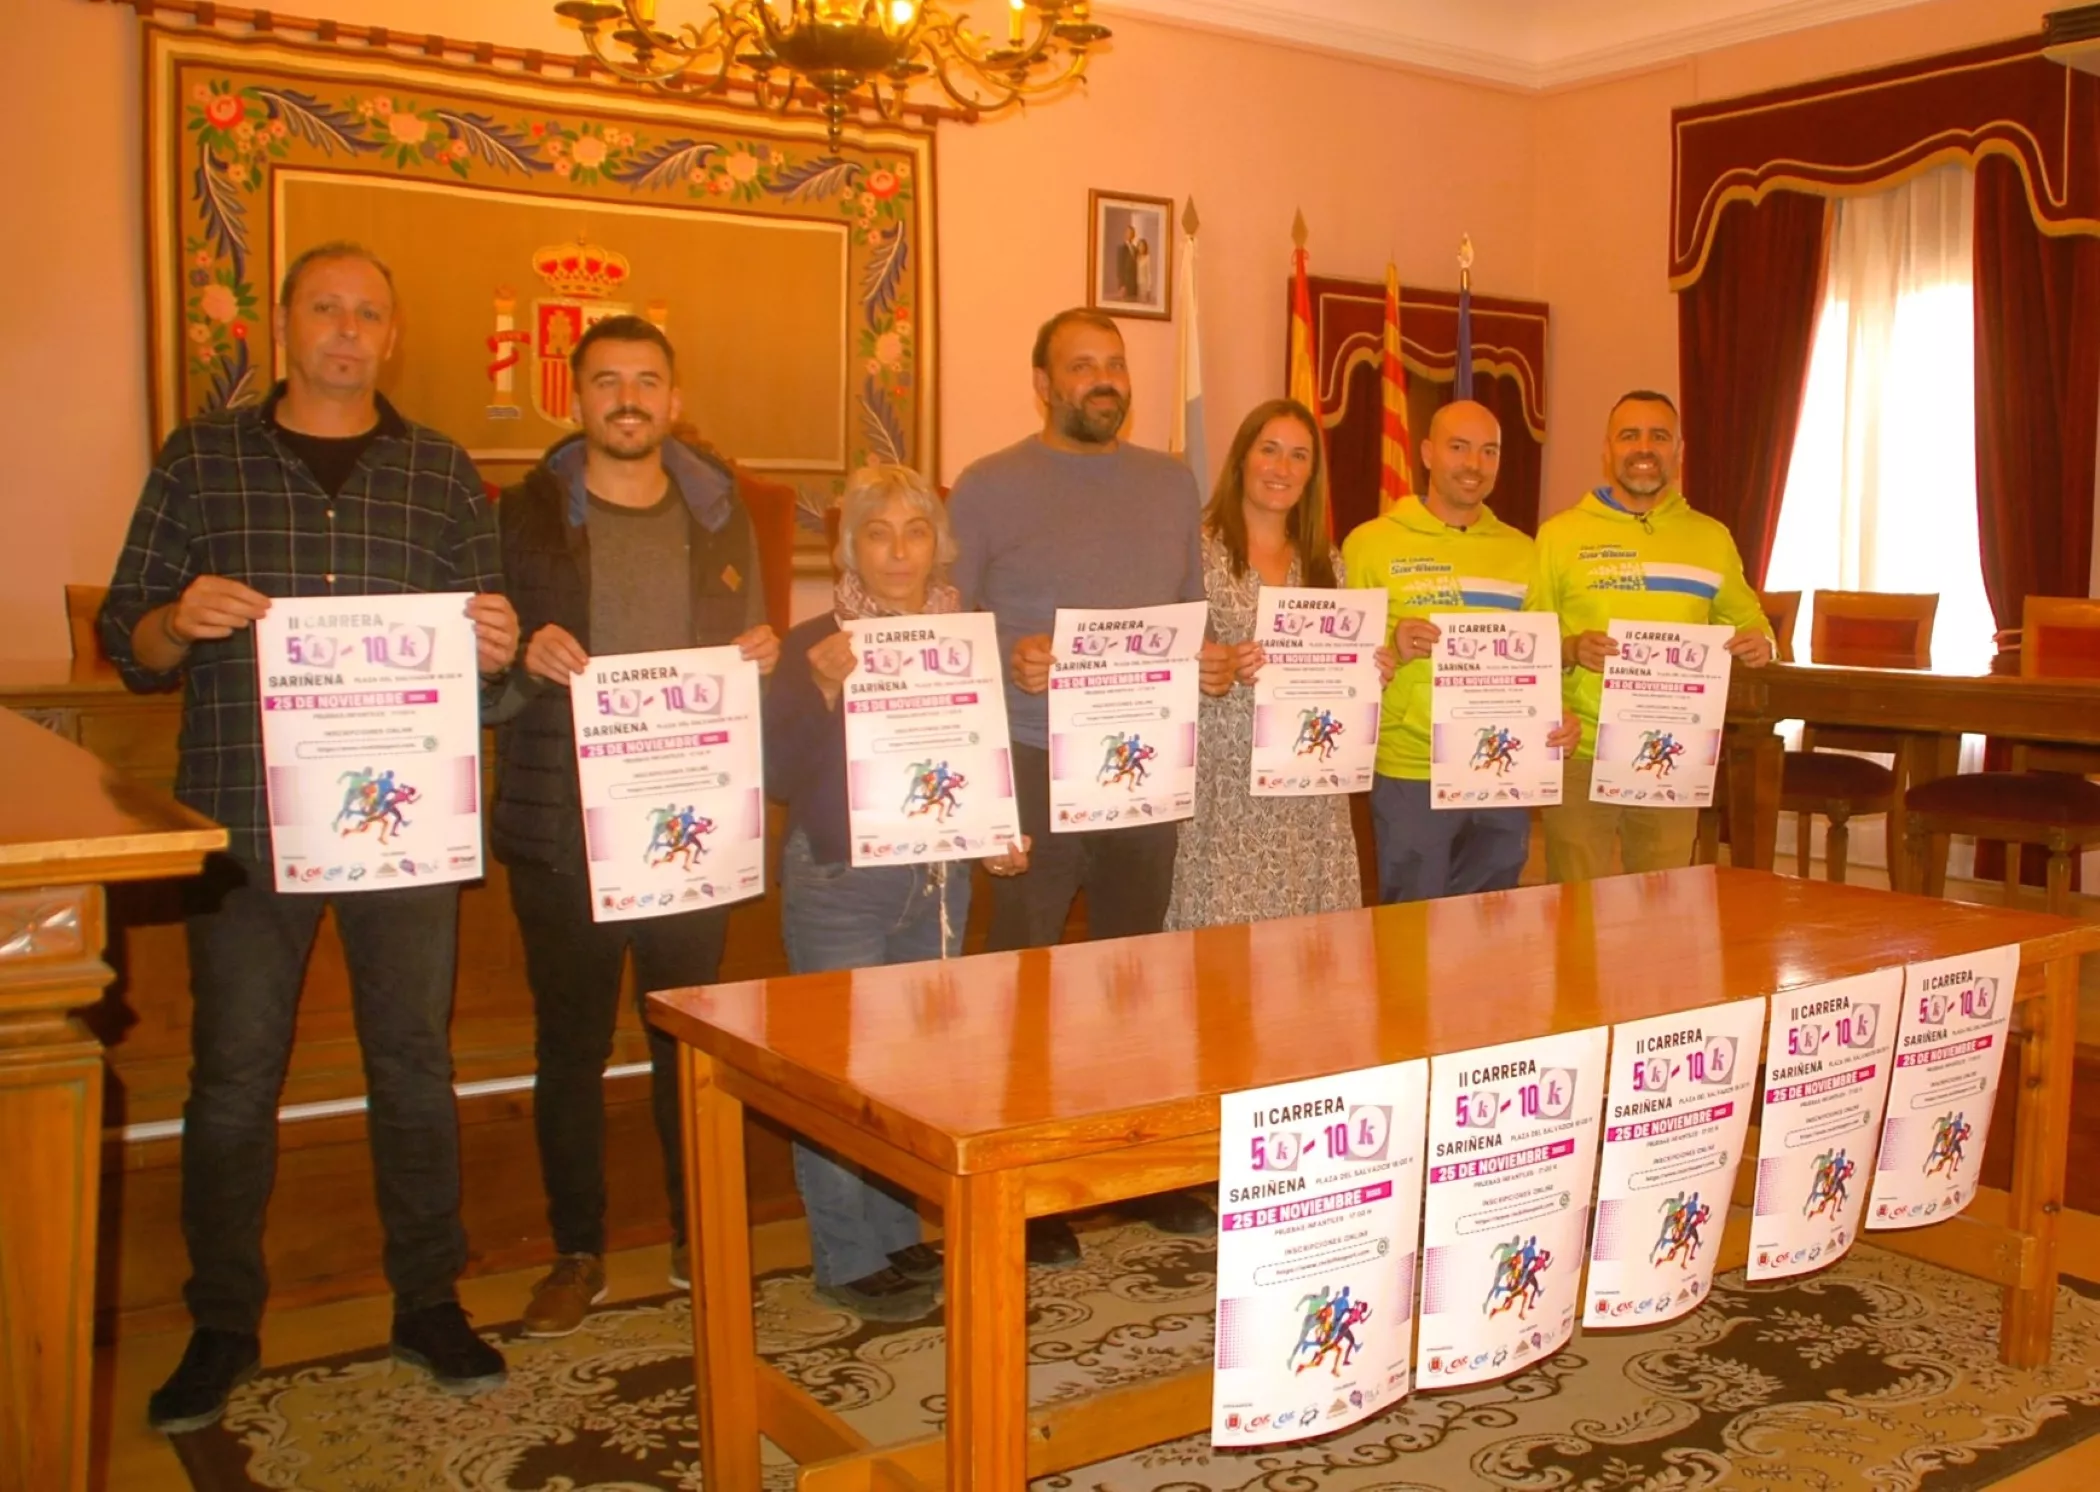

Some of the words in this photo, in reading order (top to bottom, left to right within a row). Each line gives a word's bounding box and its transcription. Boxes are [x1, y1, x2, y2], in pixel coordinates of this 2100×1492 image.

[1288, 600, 1336, 609] CARRERA
[288, 617, 299, 630] II
[304, 613, 383, 629] CARRERA
[1089, 620, 1144, 631] CARRERA
[1459, 624, 1506, 633] CARRERA
[876, 629, 936, 643] CARRERA
[1634, 631, 1680, 642] CARRERA
[1055, 659, 1107, 671] SARIÑENA
[1438, 662, 1481, 671] SARIÑENA
[1609, 666, 1651, 676] SARIÑENA
[268, 672, 344, 688] SARIÑENA
[597, 672, 606, 684] II
[610, 666, 678, 684] CARRERA
[851, 680, 908, 694] SARIÑENA
[274, 697, 293, 709] 25
[296, 696, 313, 708] DE
[318, 693, 404, 708] NOVIEMBRE
[583, 721, 648, 738] SARIÑENA
[607, 743, 624, 755] DE
[1932, 970, 1973, 990] CARRERA
[1791, 1008, 1798, 1021] II
[1801, 996, 1849, 1018] CARRERA
[1637, 1040, 1644, 1054] II
[1648, 1028, 1702, 1052] CARRERA
[1904, 1029, 1947, 1047] SARIÑENA
[1459, 1072, 1468, 1087] II
[1472, 1059, 1536, 1085] CARRERA
[1772, 1060, 1823, 1081] SARIÑENA
[1774, 1089, 1787, 1101] 25
[1789, 1086, 1802, 1097] DE
[1805, 1072, 1857, 1095] NOVIEMBRE
[1254, 1112, 1263, 1128] II
[1269, 1096, 1344, 1124] CARRERA
[1615, 1097, 1672, 1118] SARIÑENA
[1615, 1127, 1631, 1140] 25
[1634, 1124, 1649, 1137] DE
[1652, 1109, 1712, 1134] NOVIEMBRE
[1437, 1134, 1502, 1157] SARIÑENA
[1438, 1167, 1455, 1182] 25
[1459, 1163, 1475, 1178] DE
[1479, 1145, 1549, 1175] NOVIEMBRE
[1230, 1177, 1306, 1203] SARIÑENA
[1232, 1213, 1252, 1229] 25
[1257, 1209, 1276, 1225] DE
[1280, 1189, 1362, 1221] NOVIEMBRE
